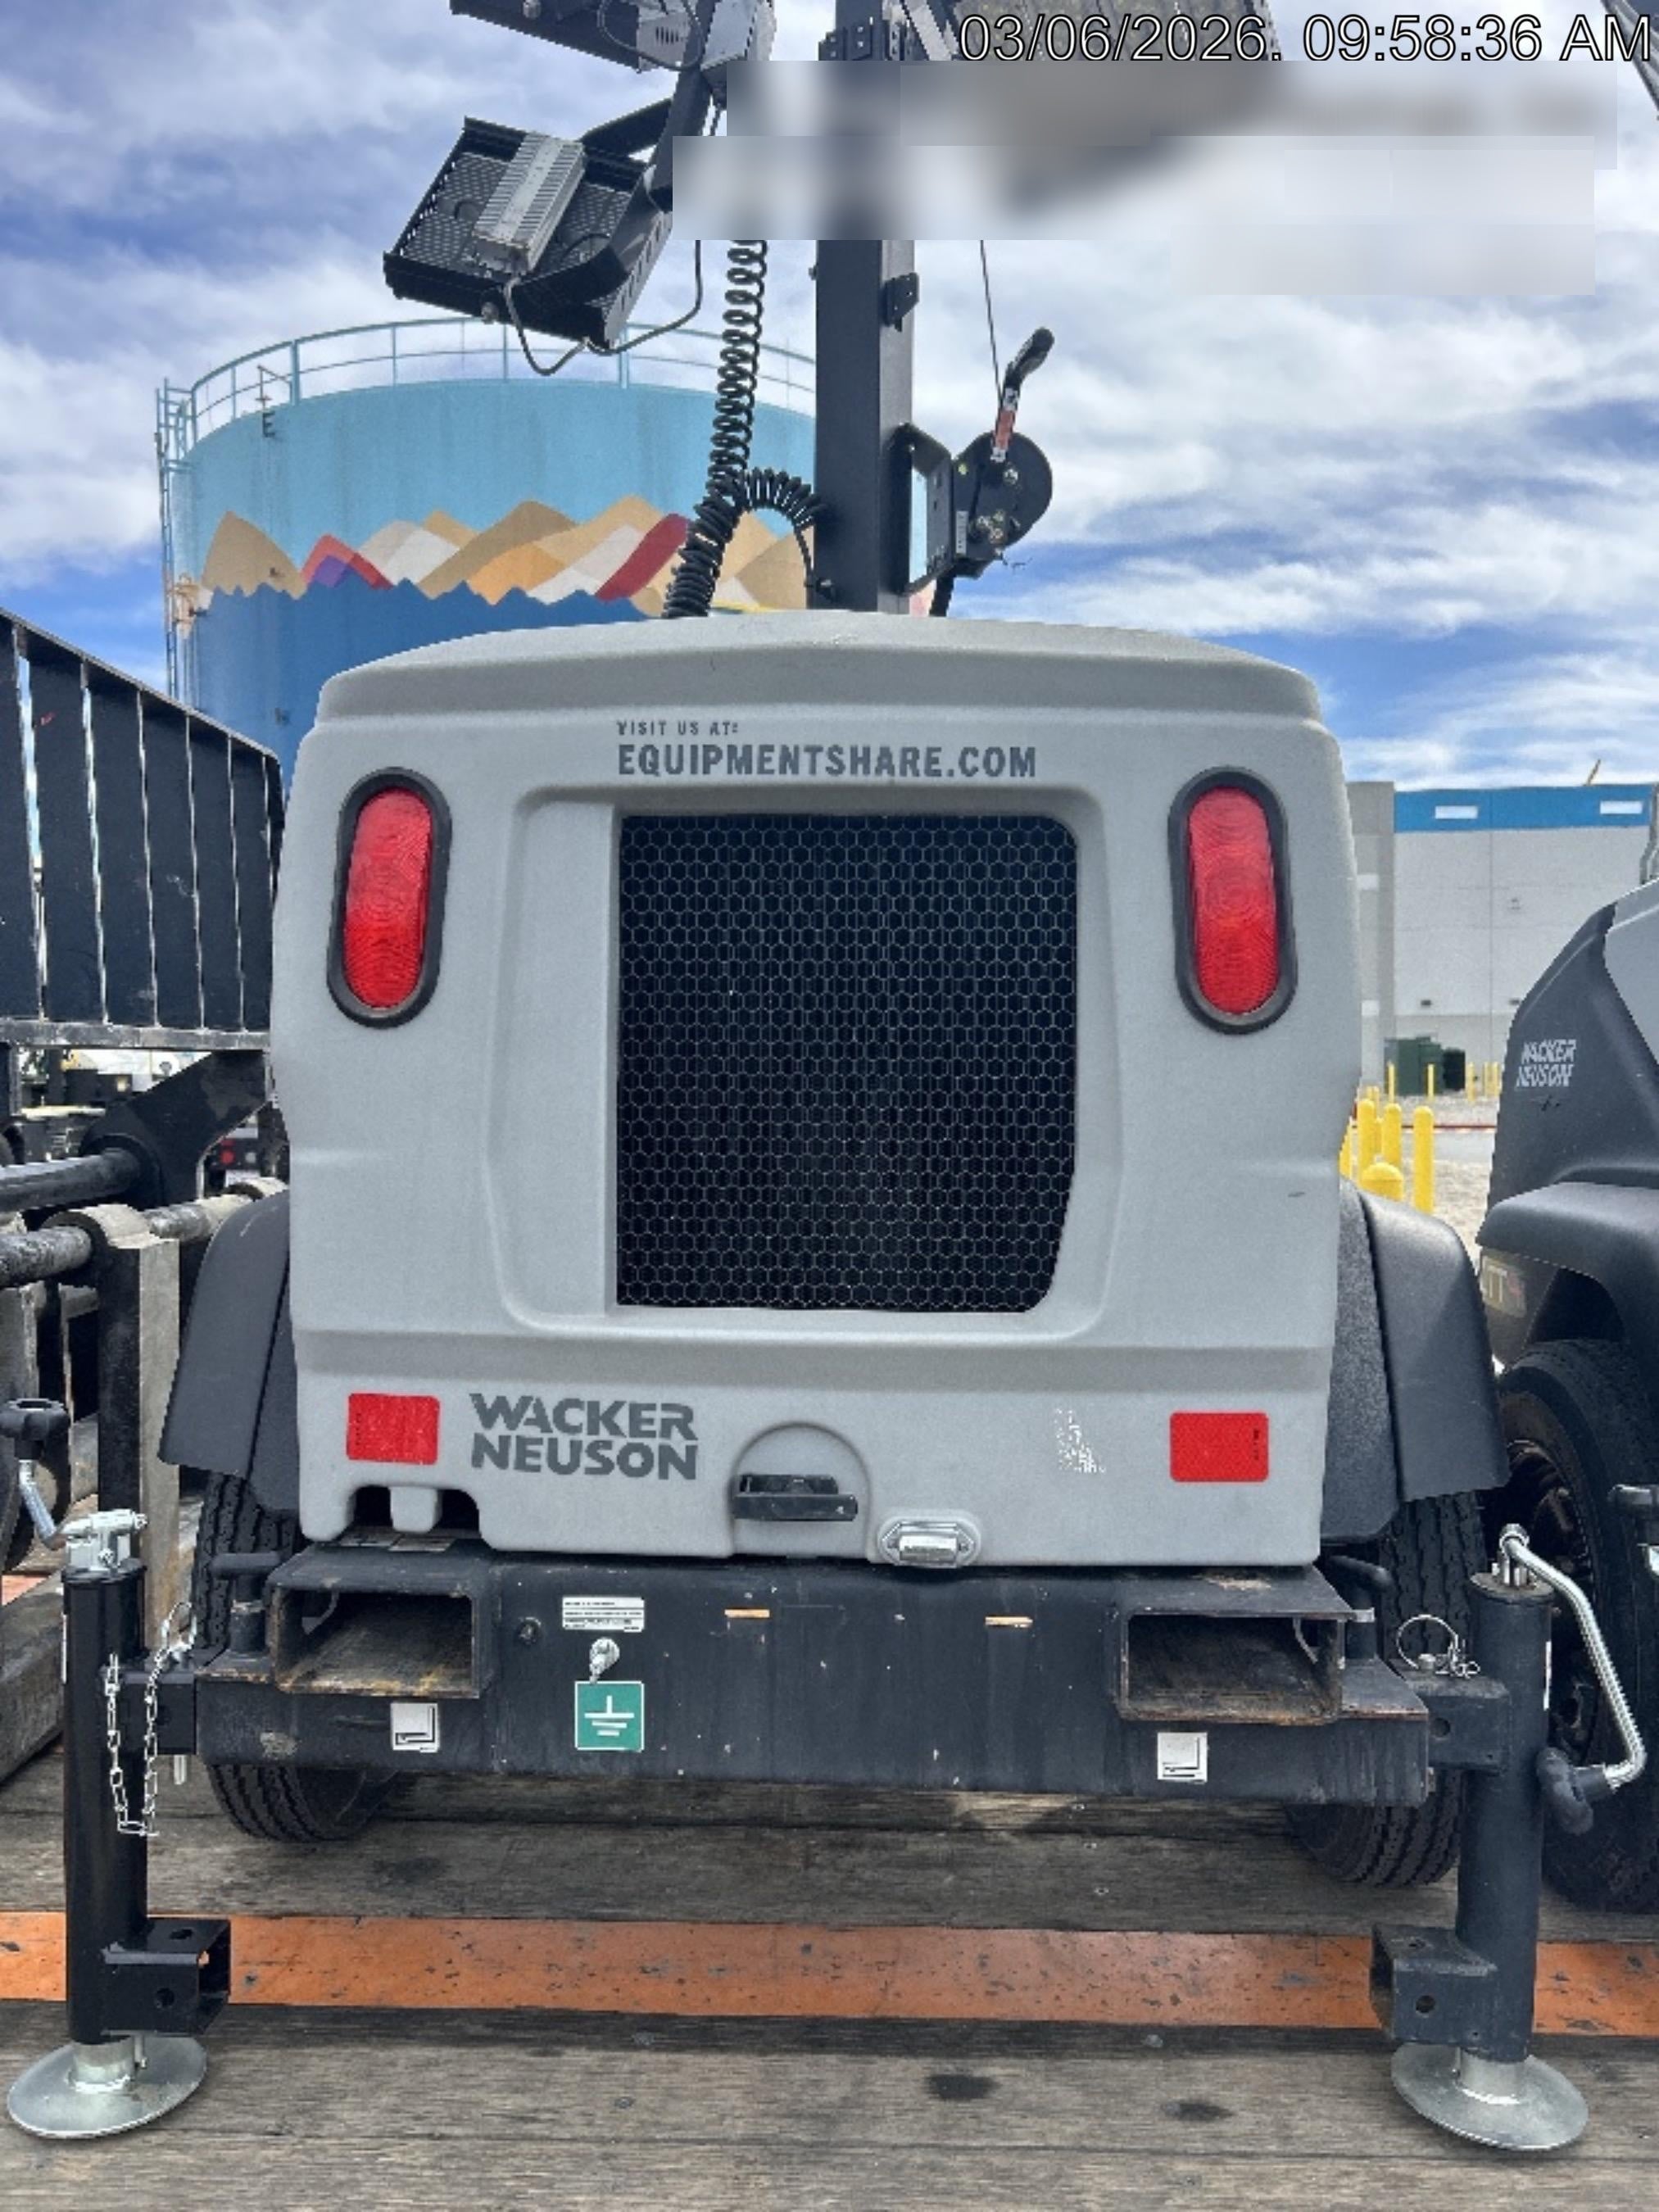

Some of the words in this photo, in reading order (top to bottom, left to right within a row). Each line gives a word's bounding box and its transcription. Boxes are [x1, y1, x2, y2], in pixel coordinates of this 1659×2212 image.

[616, 720, 667, 736] VISIT
[678, 720, 699, 736] US
[709, 721, 738, 736] AT:
[618, 743, 1036, 778] EQUIPMENTSHARE.COM
[1521, 1039, 1576, 1064] WACKER
[469, 1393, 699, 1441] WACKER
[471, 1432, 699, 1480] NEUSON
